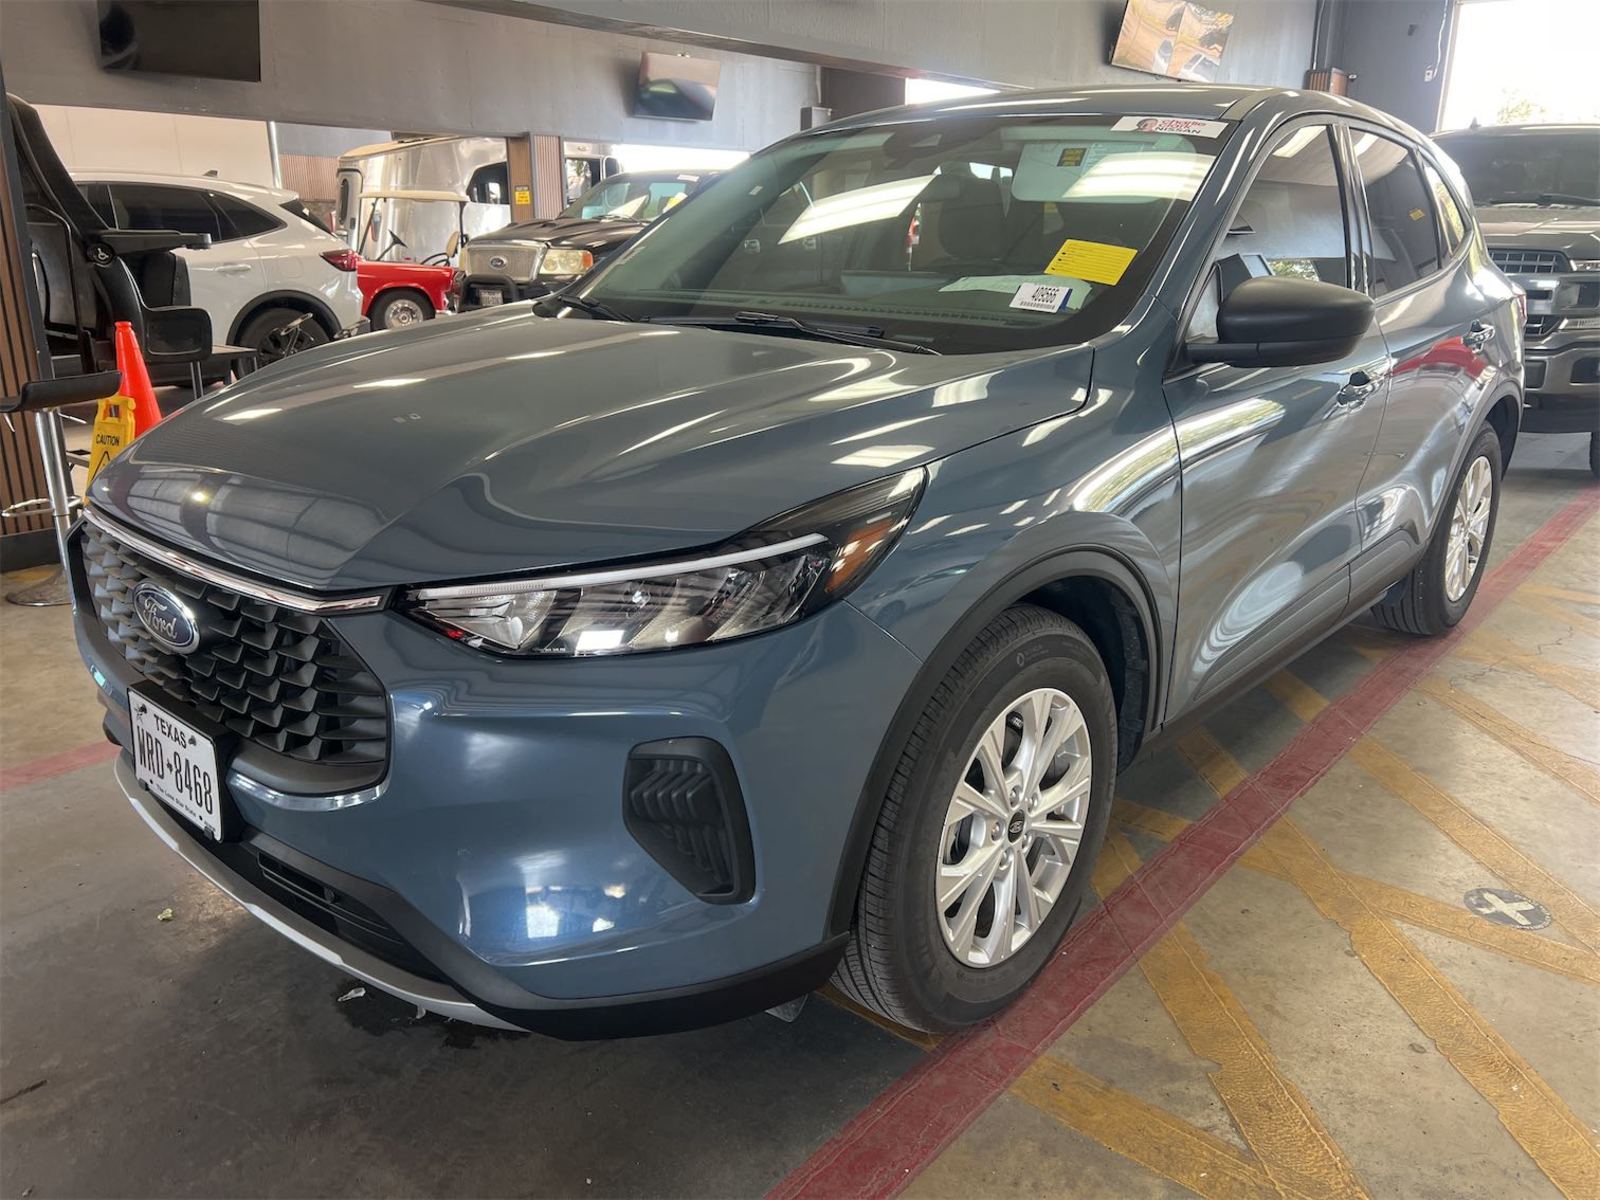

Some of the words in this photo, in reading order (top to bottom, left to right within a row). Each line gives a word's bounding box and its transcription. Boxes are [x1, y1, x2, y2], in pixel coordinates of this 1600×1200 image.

[96, 434, 120, 446] CAUTION
[143, 596, 178, 639] Ford
[154, 714, 187, 749] TEXAS
